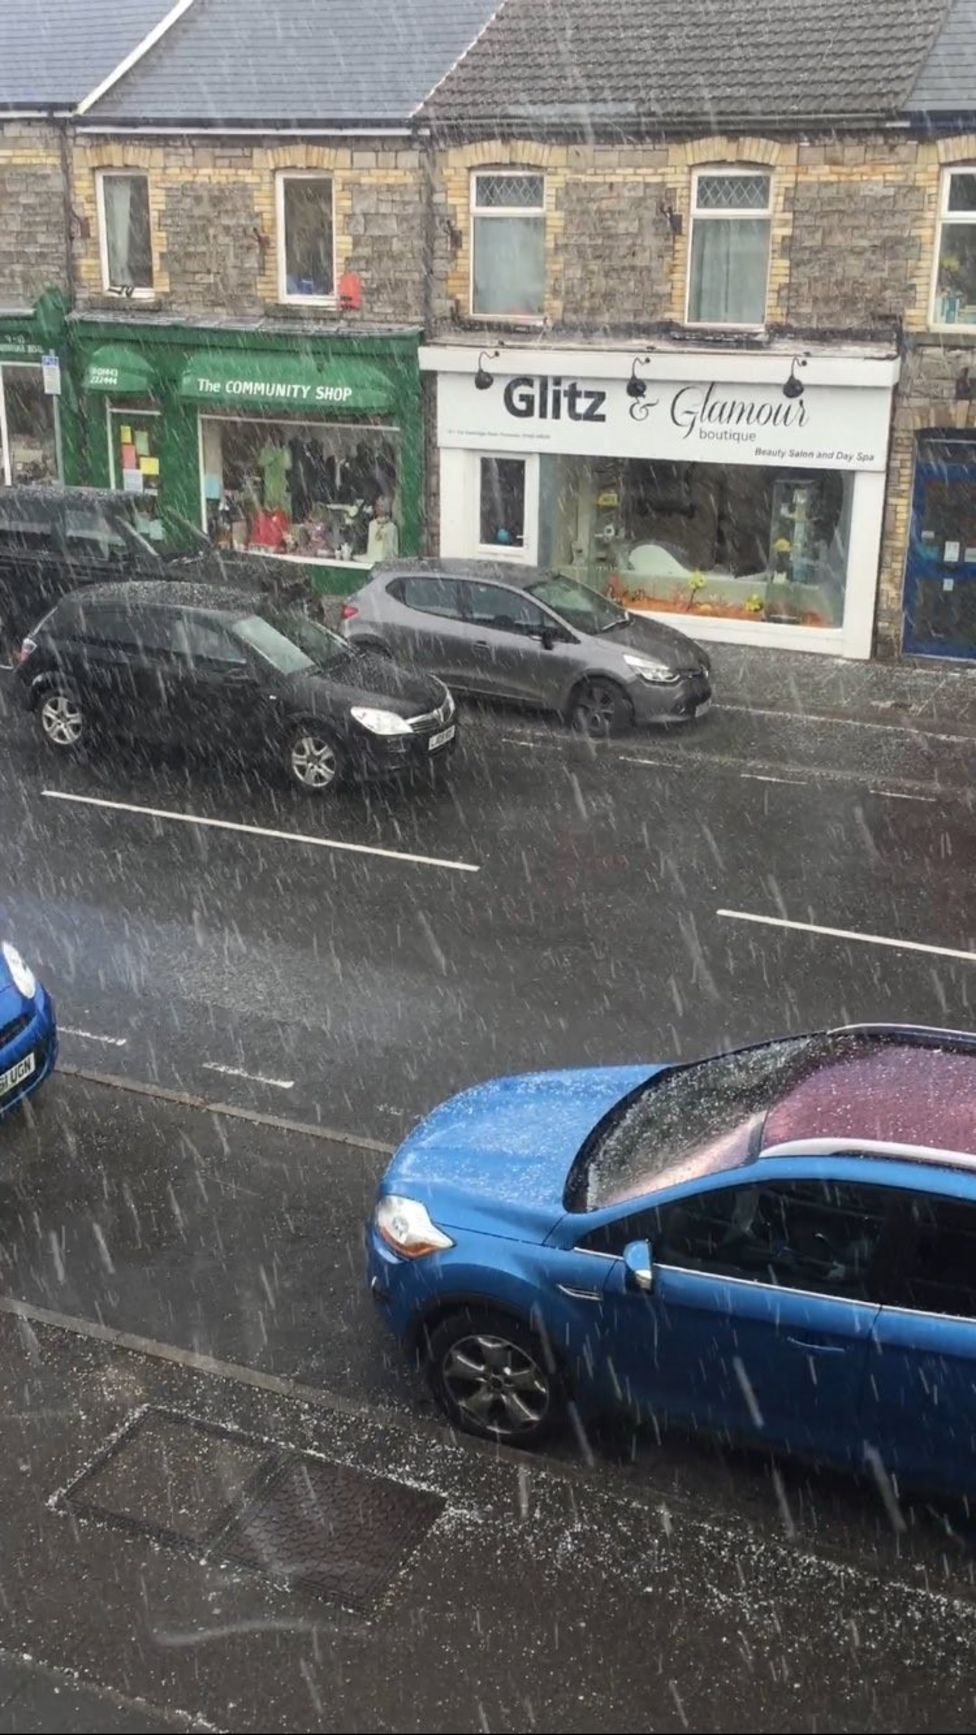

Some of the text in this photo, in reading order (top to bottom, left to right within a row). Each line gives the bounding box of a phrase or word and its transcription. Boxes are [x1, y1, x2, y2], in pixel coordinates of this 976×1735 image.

[197, 378, 352, 402] The COMMUNITY SHOP
[503, 375, 809, 439] Glitz & Glamour
[699, 429, 757, 443] boutique
[754, 447, 875, 463] Beauty Salon and Day Spa
[10, 1056, 31, 1083] UGN
